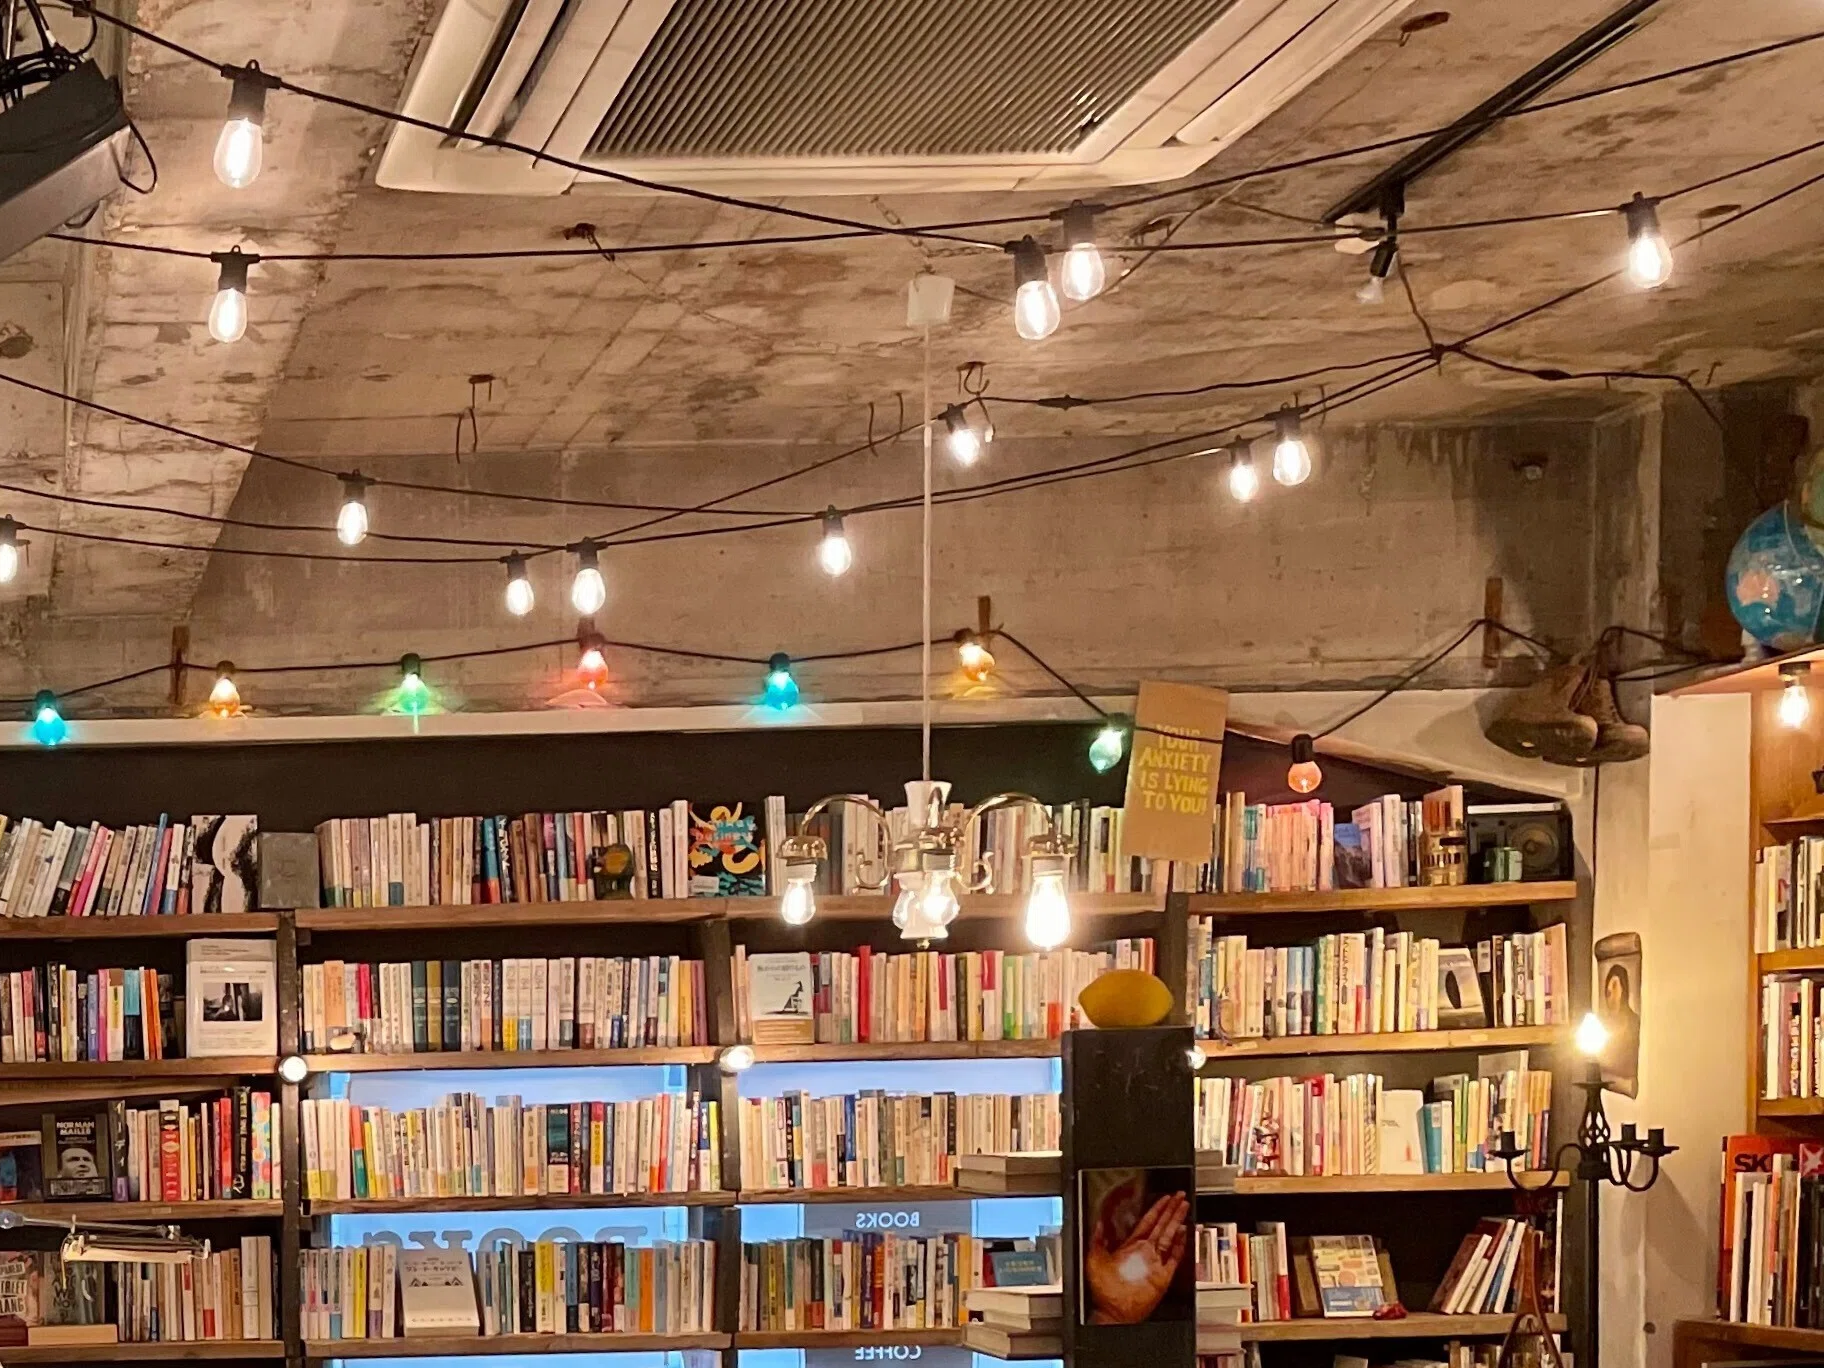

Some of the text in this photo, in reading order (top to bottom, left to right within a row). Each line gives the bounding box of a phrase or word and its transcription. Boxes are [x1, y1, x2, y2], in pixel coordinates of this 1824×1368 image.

[1137, 746, 1212, 773] ANXIETY
[1139, 769, 1209, 795] IS LYING
[1143, 790, 1166, 811] TO
